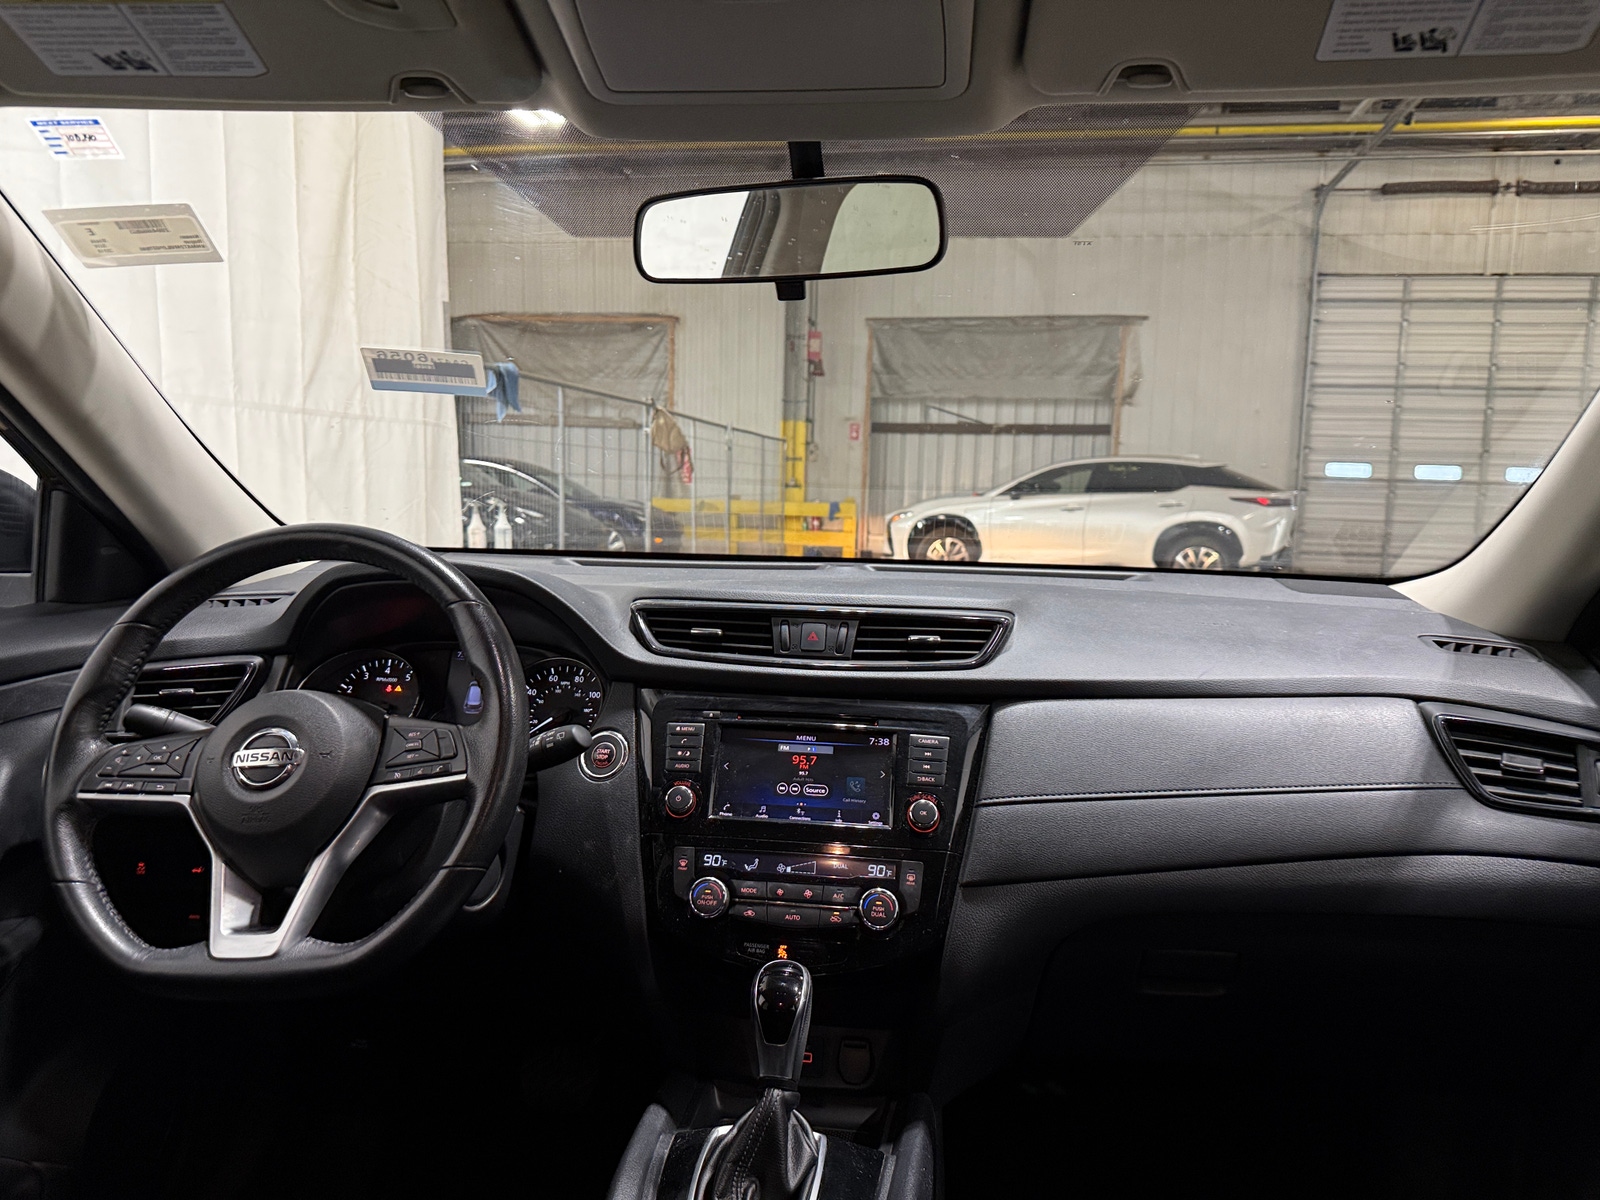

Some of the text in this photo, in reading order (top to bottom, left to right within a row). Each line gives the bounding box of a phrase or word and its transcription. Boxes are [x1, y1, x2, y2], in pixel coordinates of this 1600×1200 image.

[363, 672, 369, 680] 3
[405, 674, 412, 682] 5
[574, 675, 585, 683] 80
[346, 685, 353, 693] 2
[526, 688, 537, 696] 40
[589, 691, 601, 699] 100
[869, 737, 890, 746] 7:38
[235, 751, 294, 764] NISSAN
[792, 754, 818, 765] 95.7
